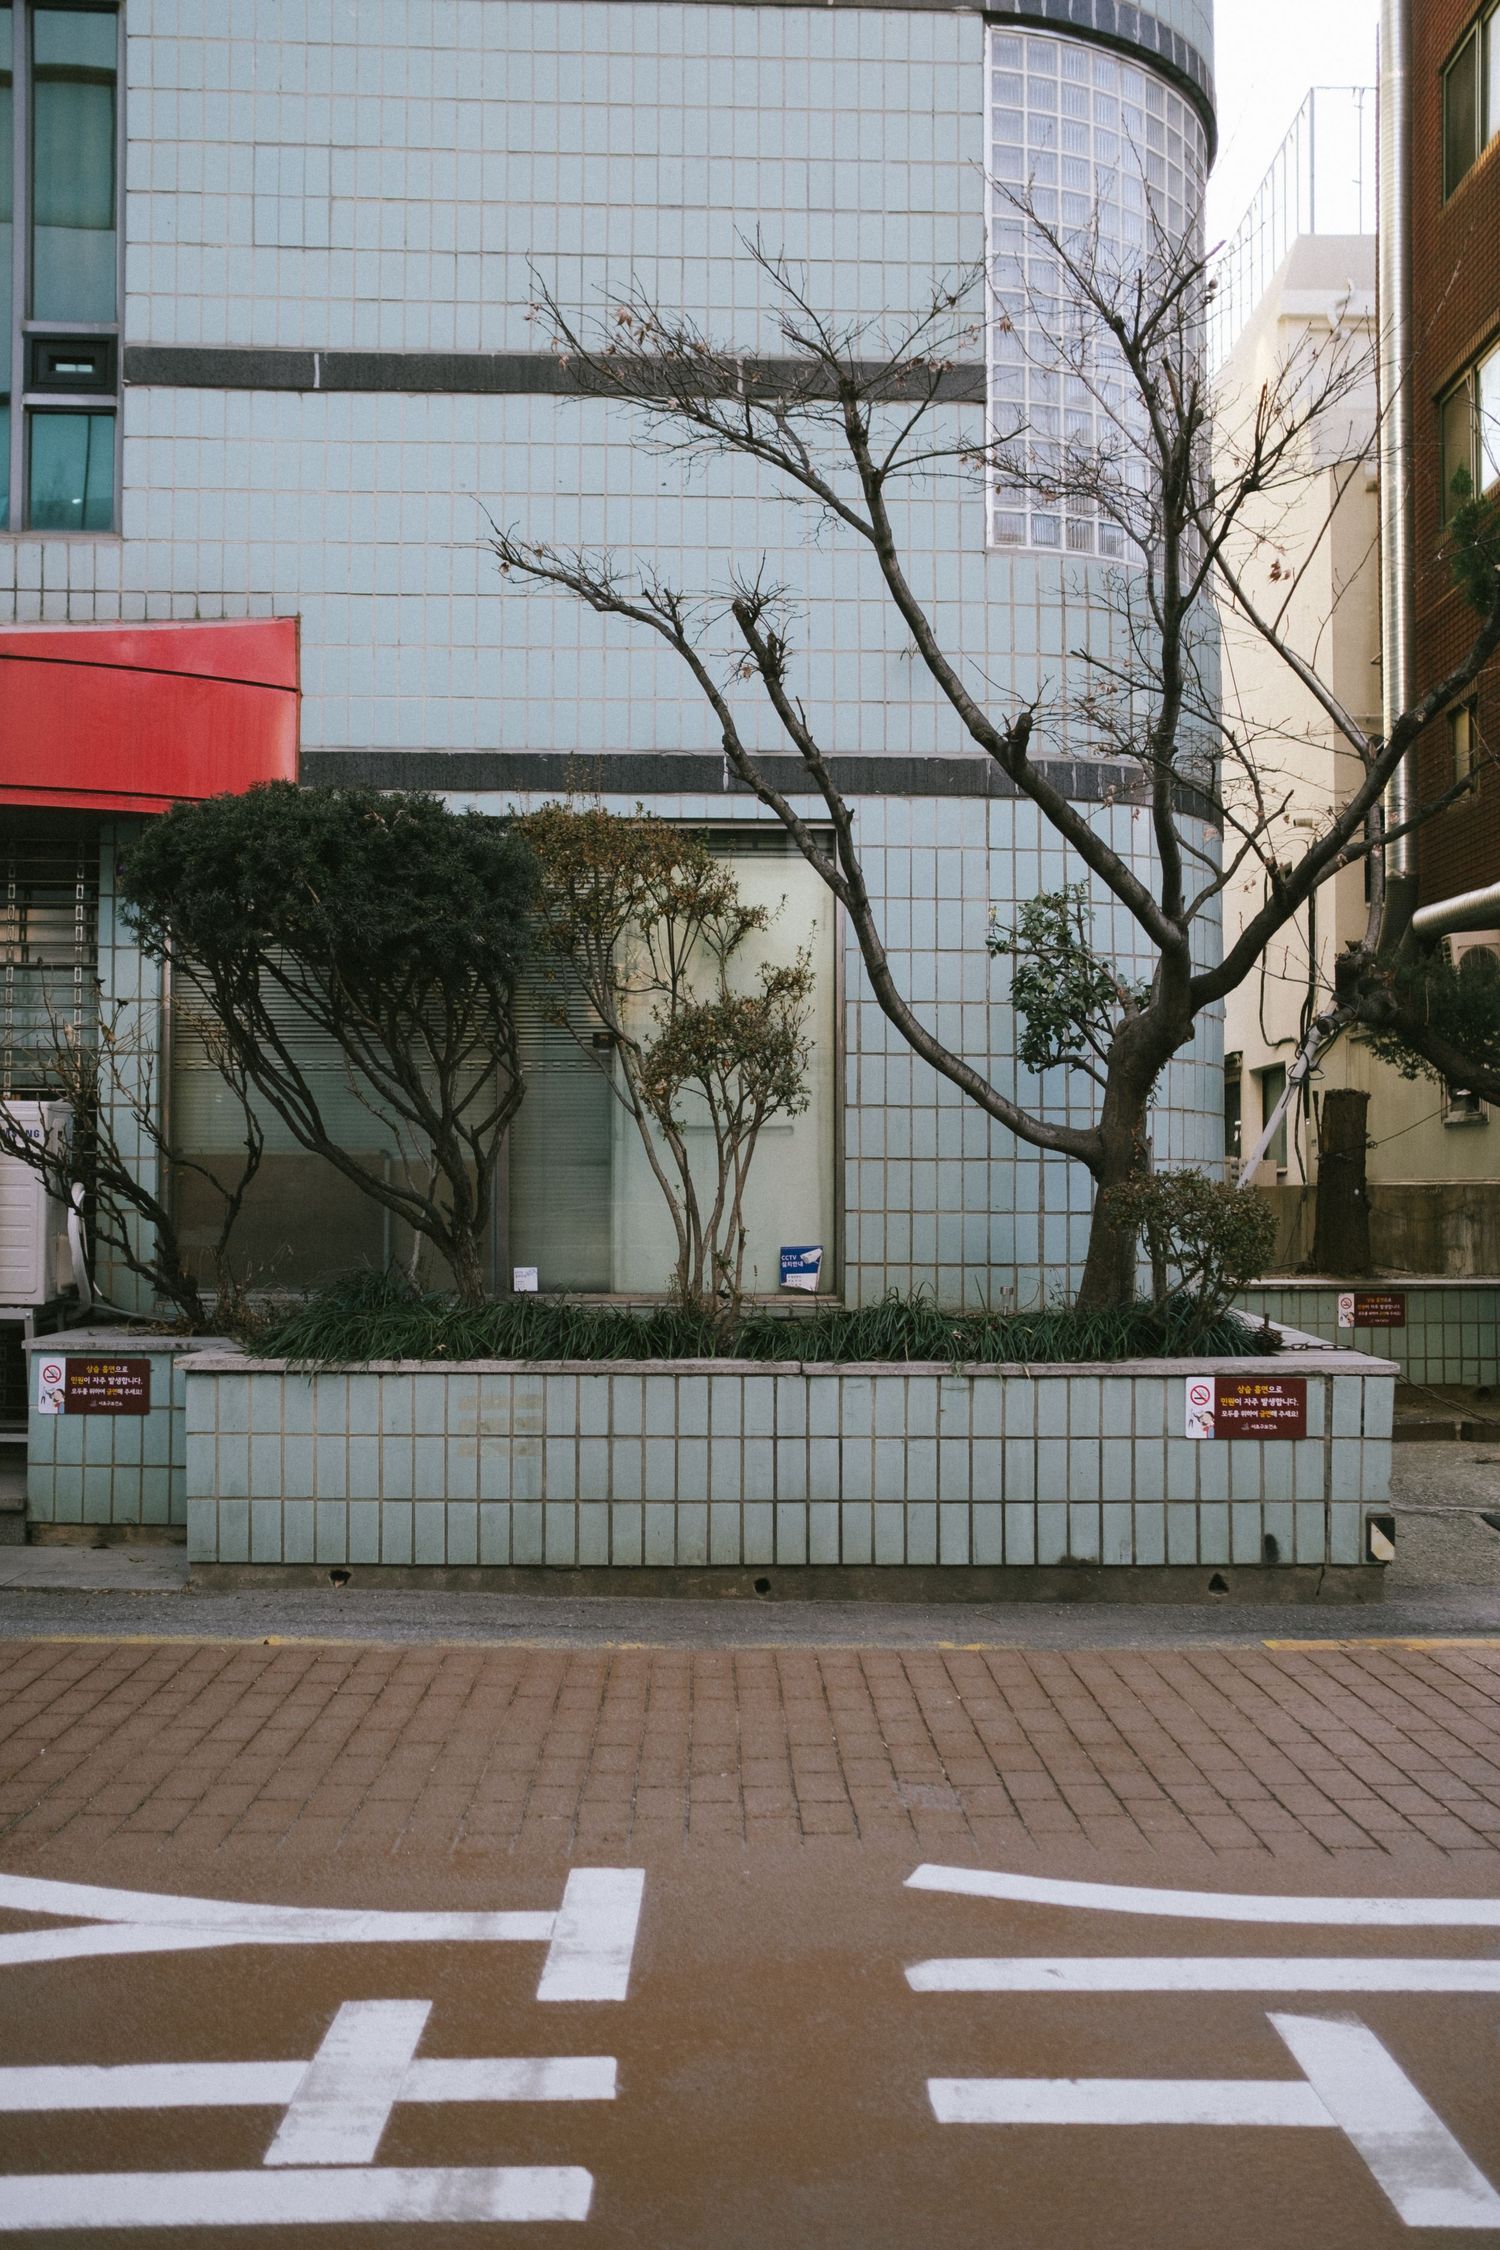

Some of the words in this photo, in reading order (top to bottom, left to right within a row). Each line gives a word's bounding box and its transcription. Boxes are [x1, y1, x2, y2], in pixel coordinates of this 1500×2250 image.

[86, 1365, 100, 1374] 상습
[70, 1376, 91, 1385] 민원이
[92, 1376, 107, 1385] 자주
[108, 1376, 143, 1385] 발생합니다.
[106, 1388, 123, 1396] 금연해
[1237, 1384, 1252, 1394] 상습
[1254, 1384, 1283, 1394] 흡연으로
[1220, 1397, 1242, 1406] 민원이
[1243, 1397, 1259, 1406] 자주
[1260, 1397, 1300, 1407] 발생합니다.
[1221, 1410, 1240, 1418] 모두를
[1240, 1410, 1259, 1418] 위하여
[1259, 1410, 1278, 1418] 금연해
[1278, 1410, 1299, 1418] 주세요!
